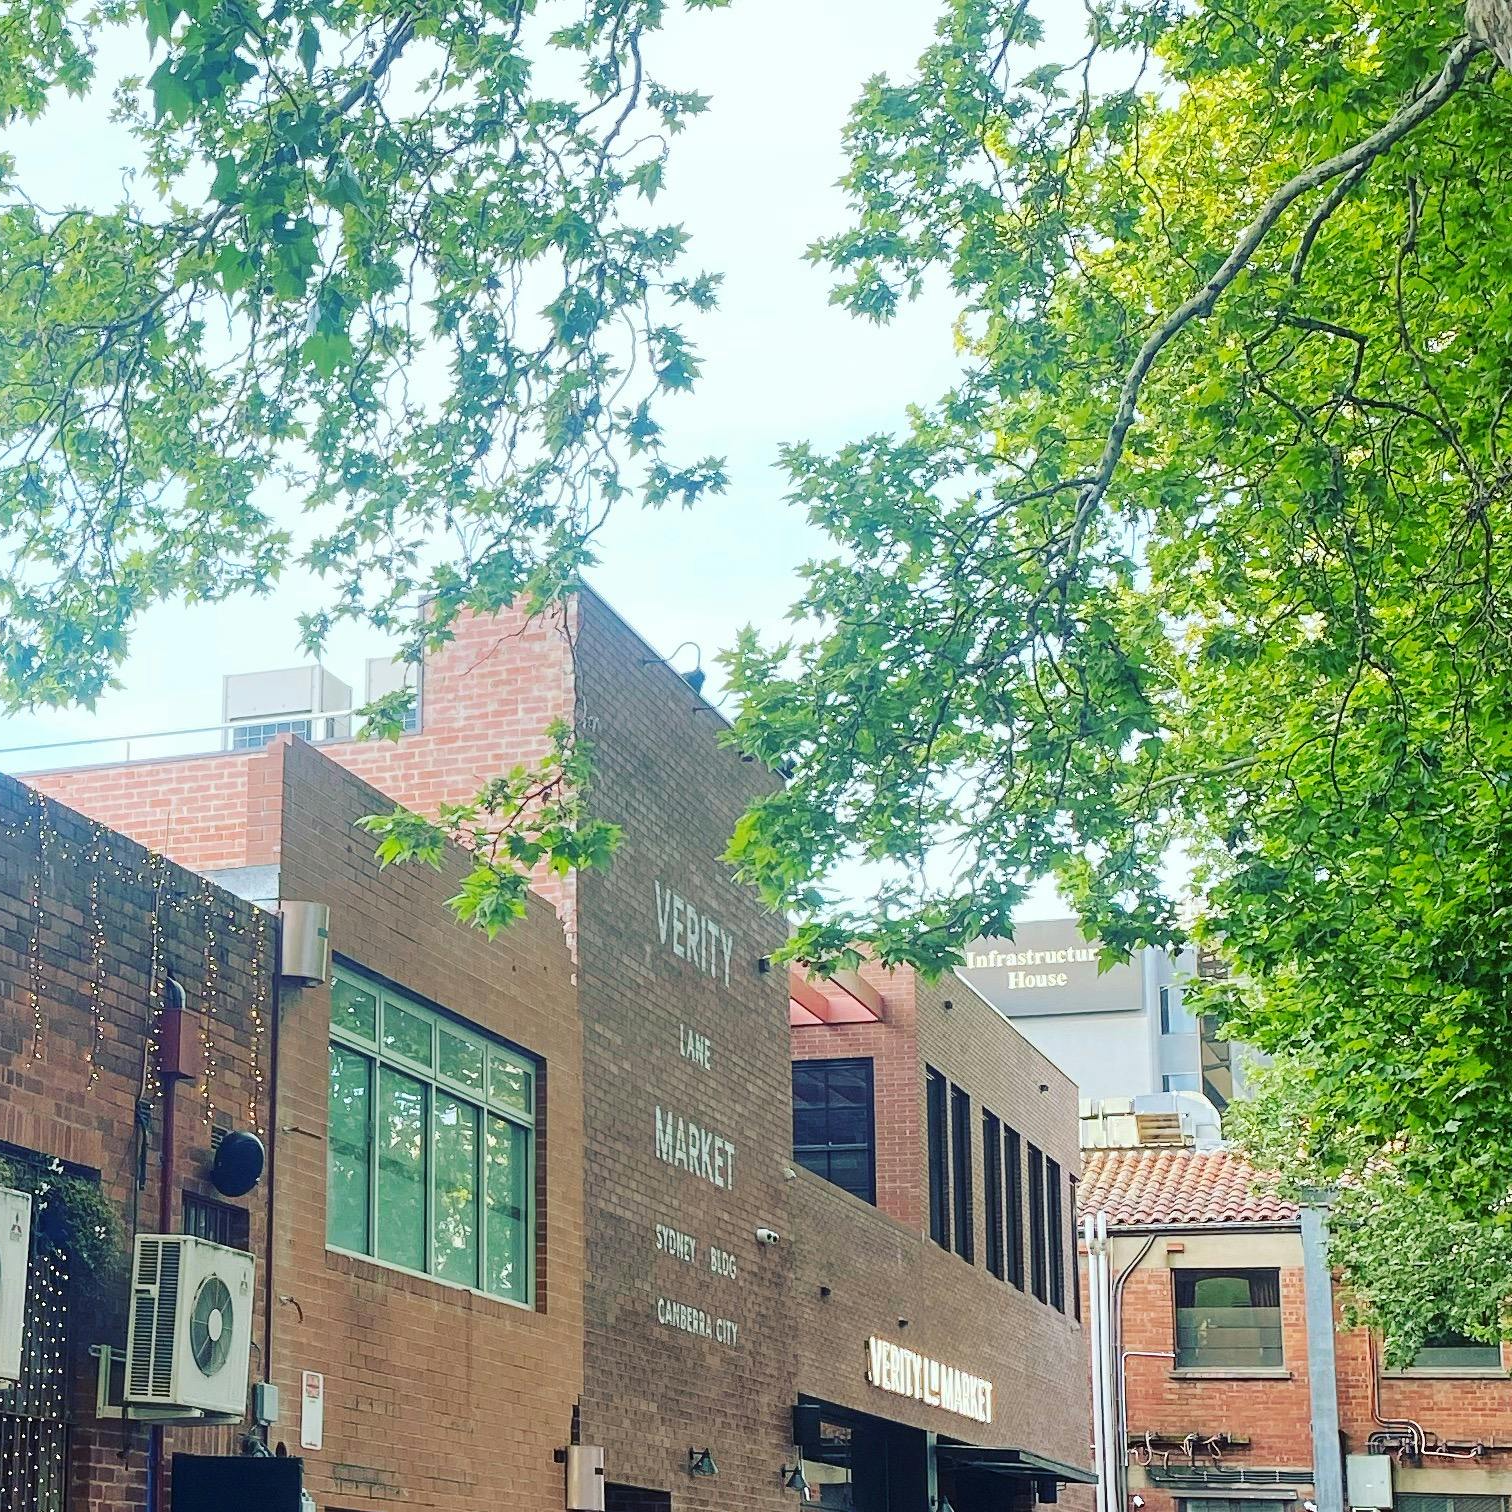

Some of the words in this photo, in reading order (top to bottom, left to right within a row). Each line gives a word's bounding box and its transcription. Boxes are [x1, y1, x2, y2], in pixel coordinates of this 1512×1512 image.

[654, 879, 733, 988] VERITY
[966, 946, 1102, 969] Infrastructur
[1008, 971, 1068, 990] House
[680, 1023, 711, 1071] LANE
[655, 1105, 735, 1190] MARKET
[656, 1223, 696, 1264] SYDNEY
[710, 1246, 737, 1280] BLDG
[657, 1298, 712, 1338] CANBERRA
[716, 1318, 738, 1347] CITY
[869, 1335, 922, 1400] VERITY
[941, 1363, 993, 1424] MARKET
